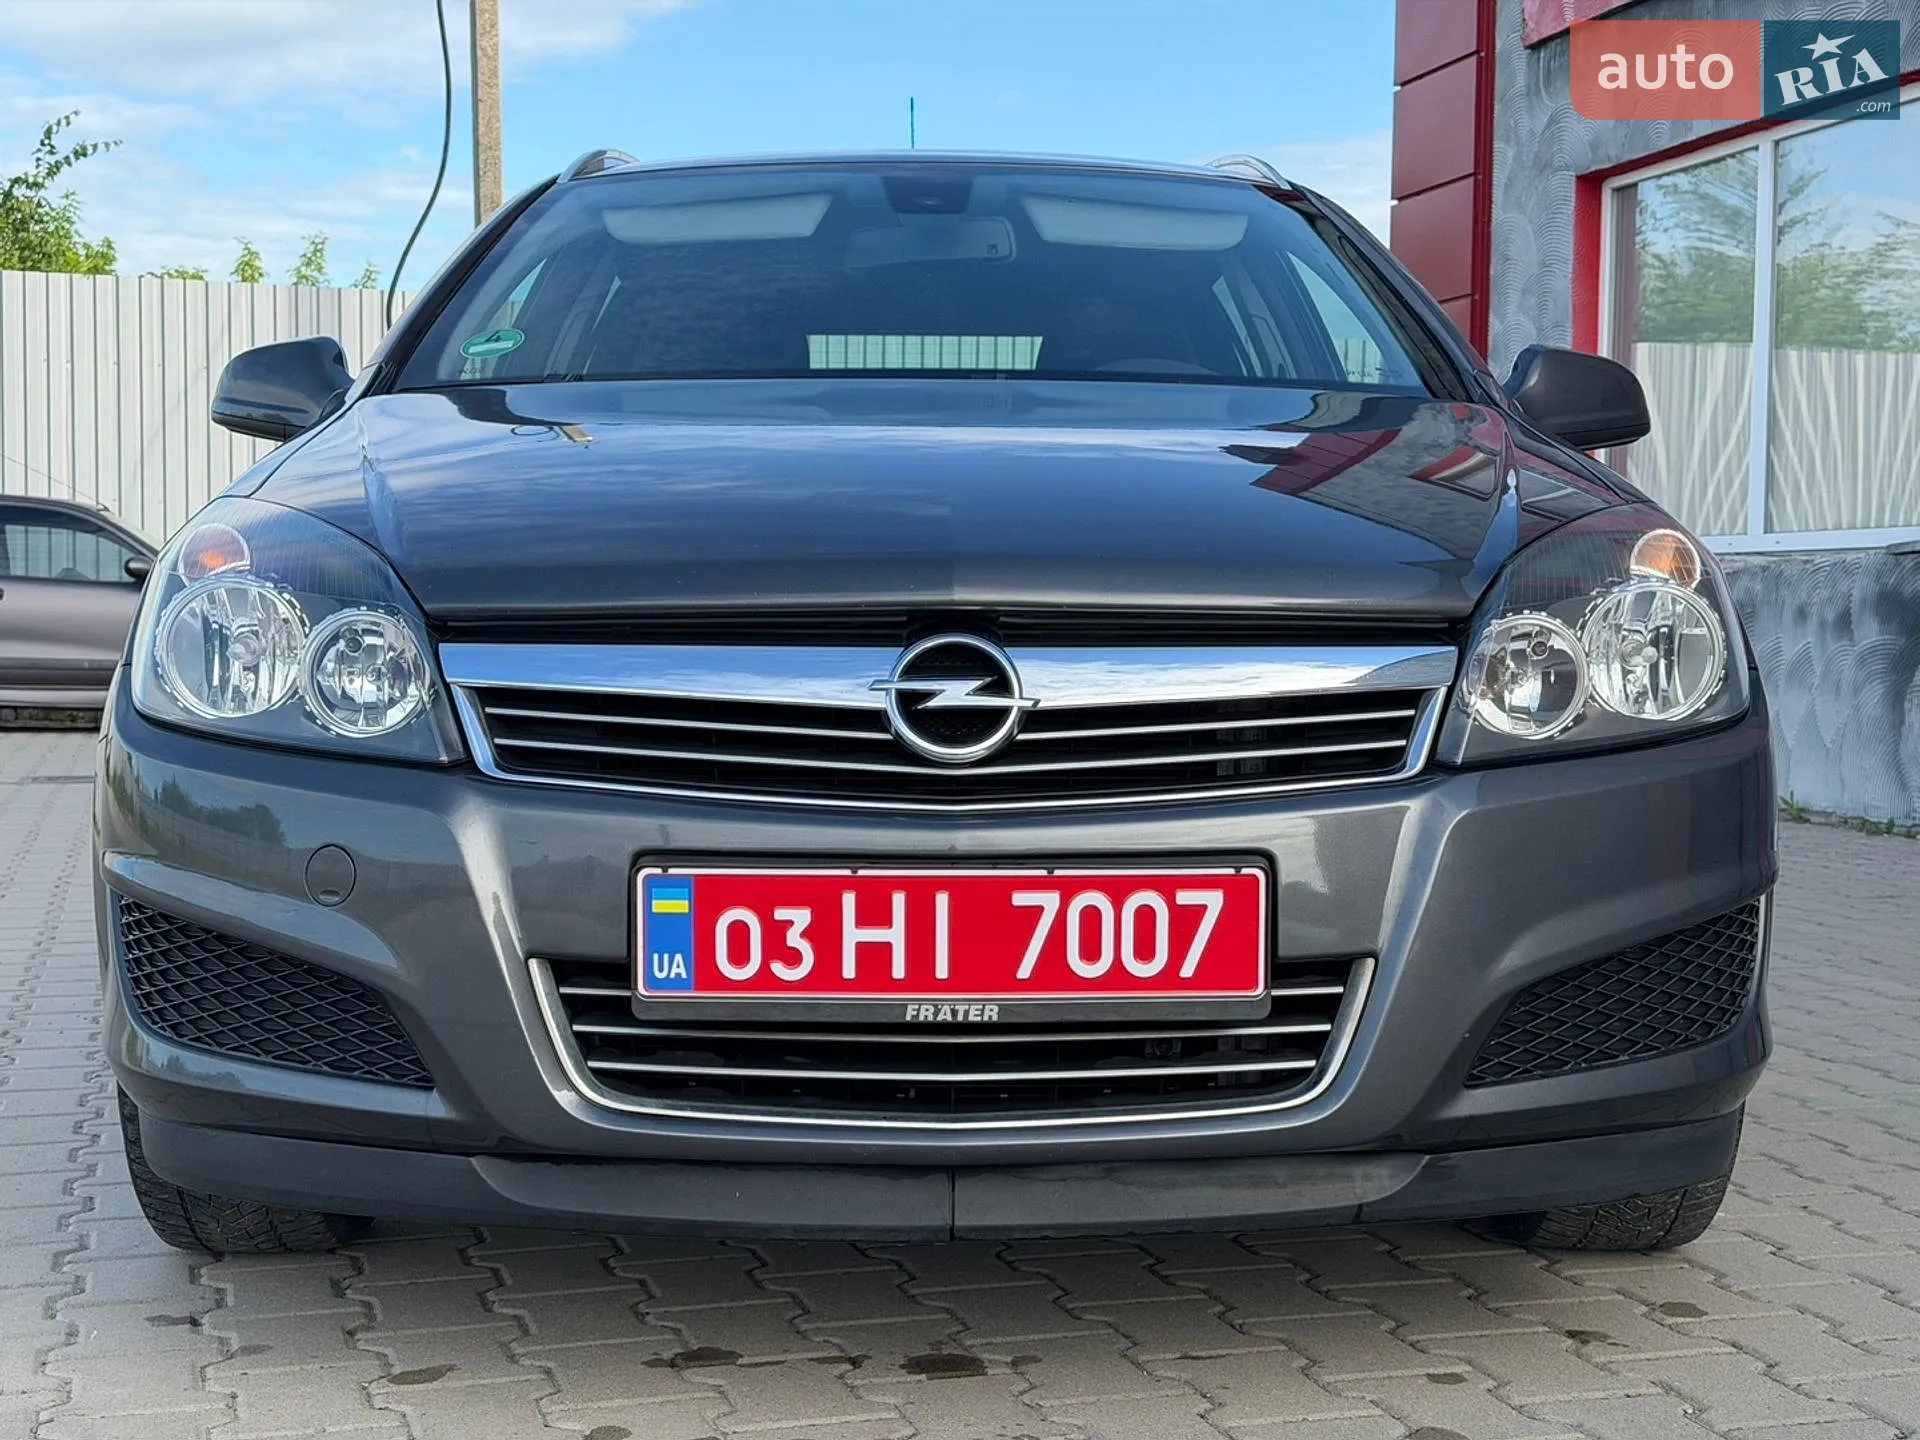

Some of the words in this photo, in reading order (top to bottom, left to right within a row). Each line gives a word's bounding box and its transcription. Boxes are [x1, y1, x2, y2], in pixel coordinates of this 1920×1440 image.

[714, 906, 814, 981] 03
[841, 890, 949, 980] HI
[1012, 890, 1224, 980] 7007
[652, 953, 688, 979] UA
